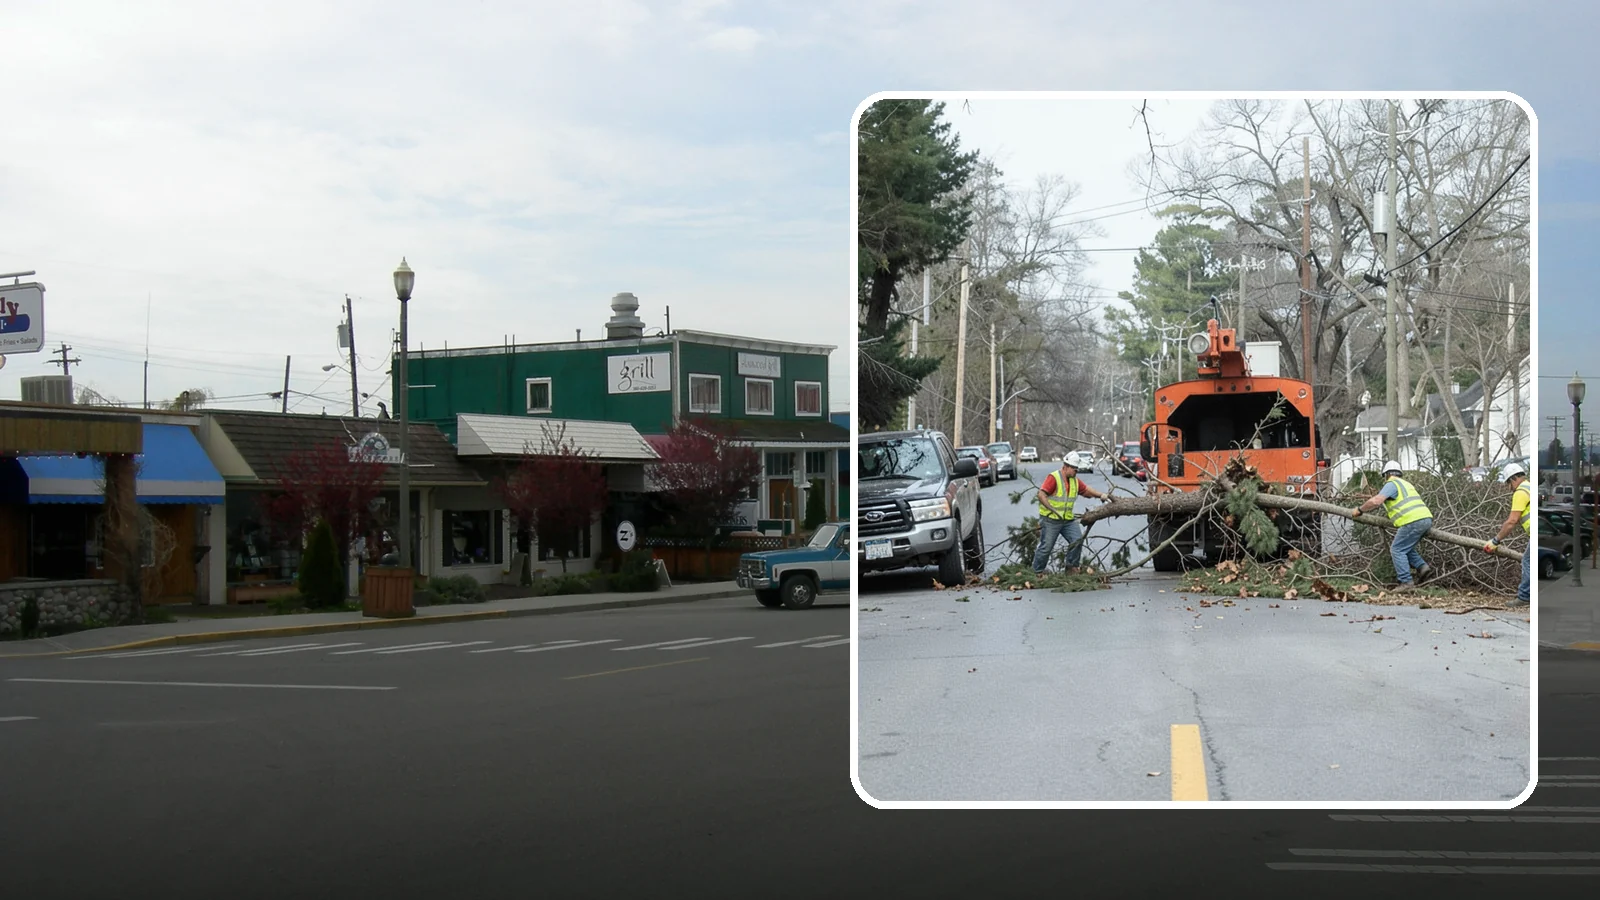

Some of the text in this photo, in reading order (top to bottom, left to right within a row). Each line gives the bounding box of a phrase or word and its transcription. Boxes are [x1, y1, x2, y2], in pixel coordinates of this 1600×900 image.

[0, 297, 20, 324] ly
[20, 337, 38, 345] Salads
[618, 356, 654, 391] grill
